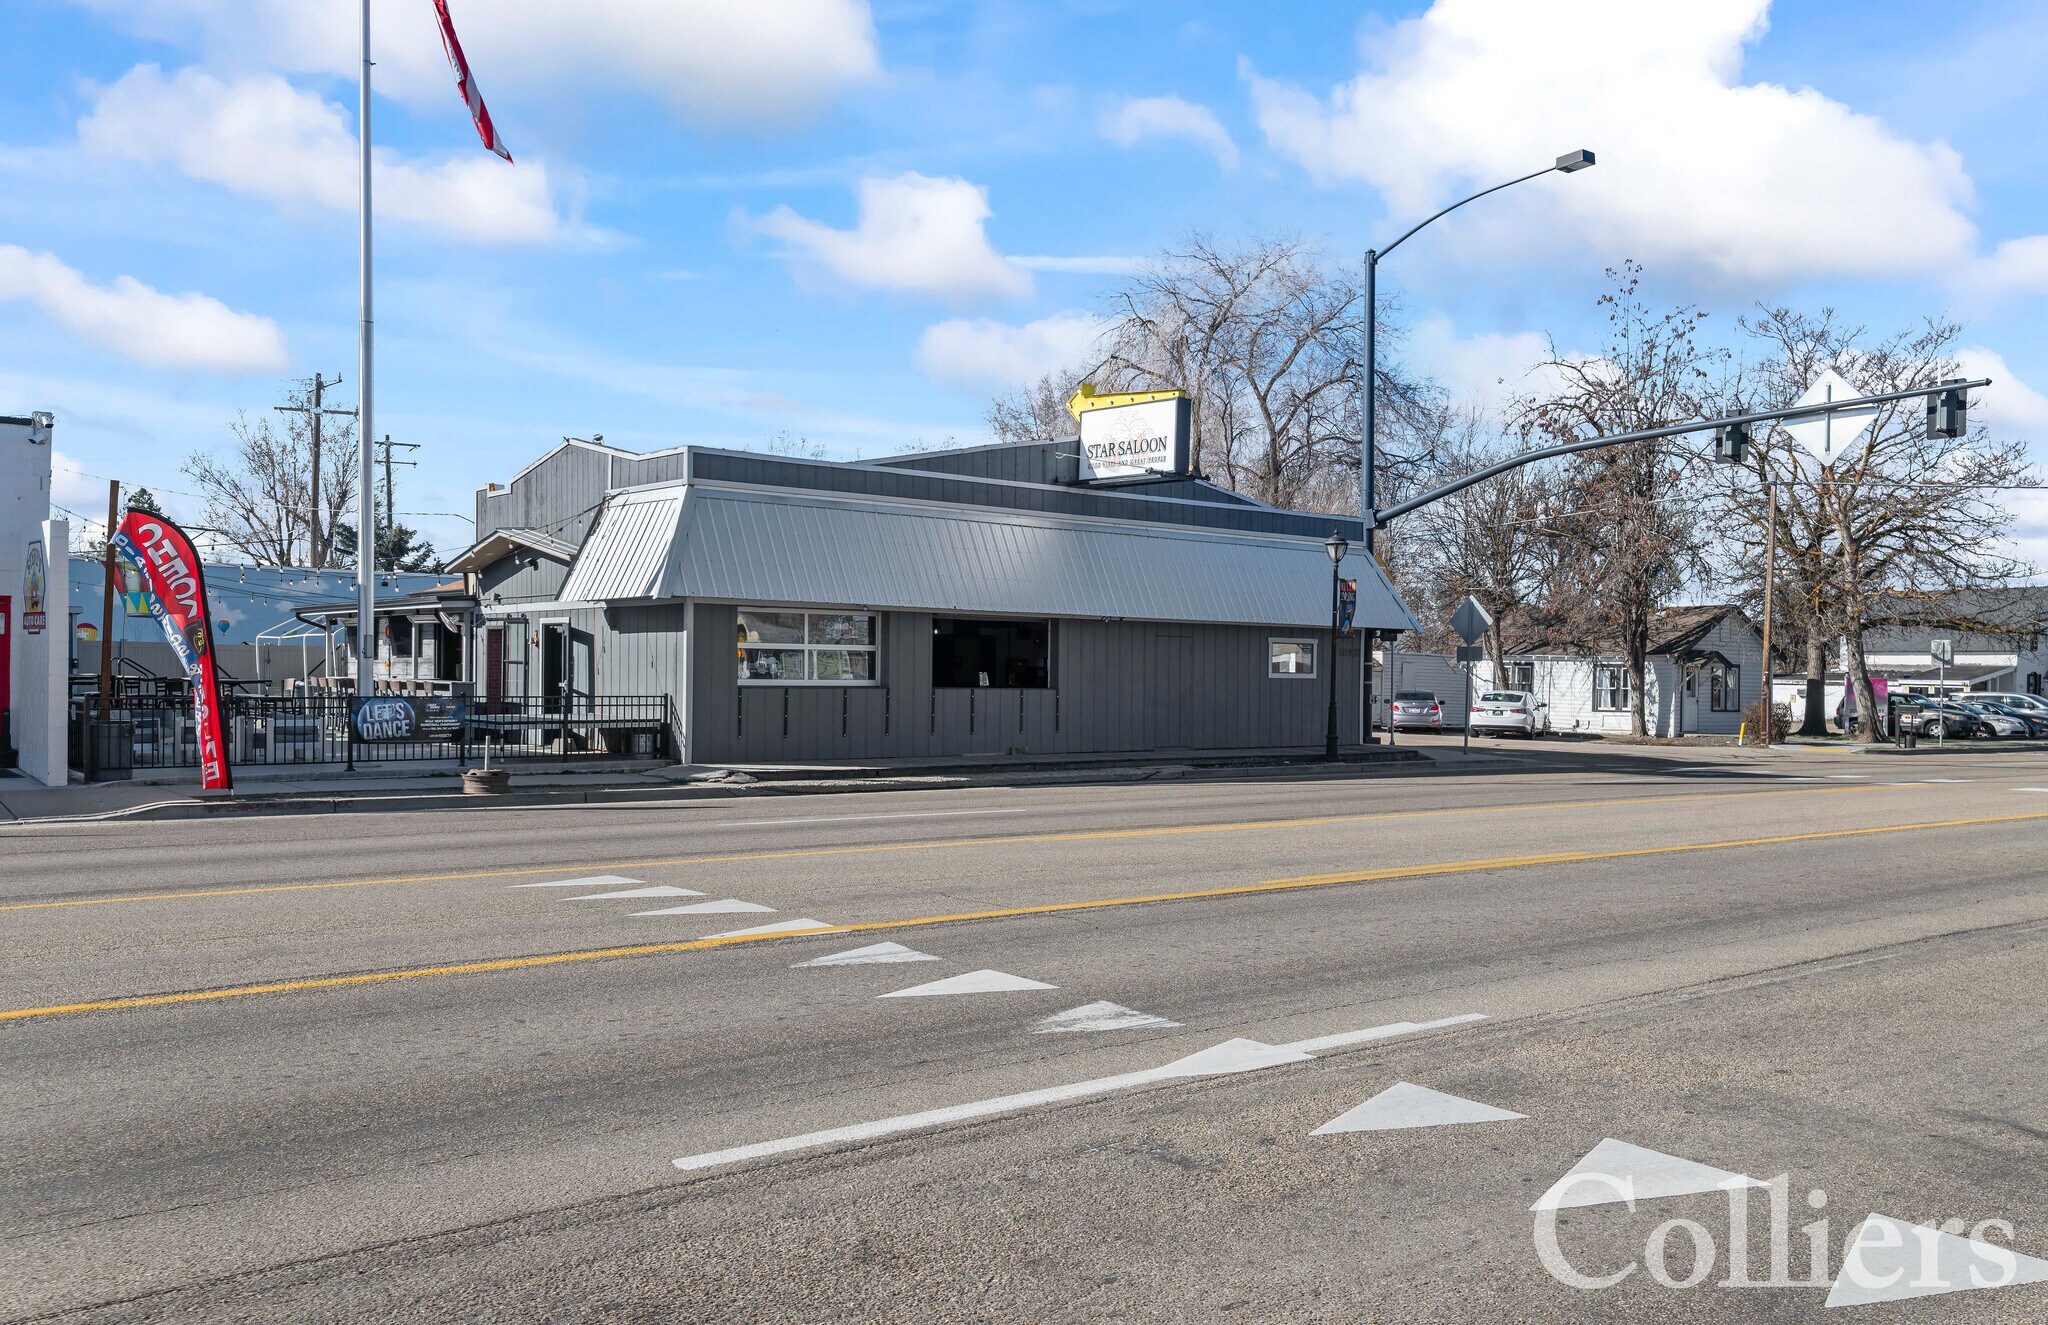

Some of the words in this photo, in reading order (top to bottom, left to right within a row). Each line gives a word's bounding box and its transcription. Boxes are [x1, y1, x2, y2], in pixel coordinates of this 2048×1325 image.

[1087, 443, 1116, 459] STAR
[1118, 436, 1168, 456] SALOON
[34, 615, 45, 626] CARE
[366, 703, 405, 722] LET'S
[363, 720, 410, 740] DANCE
